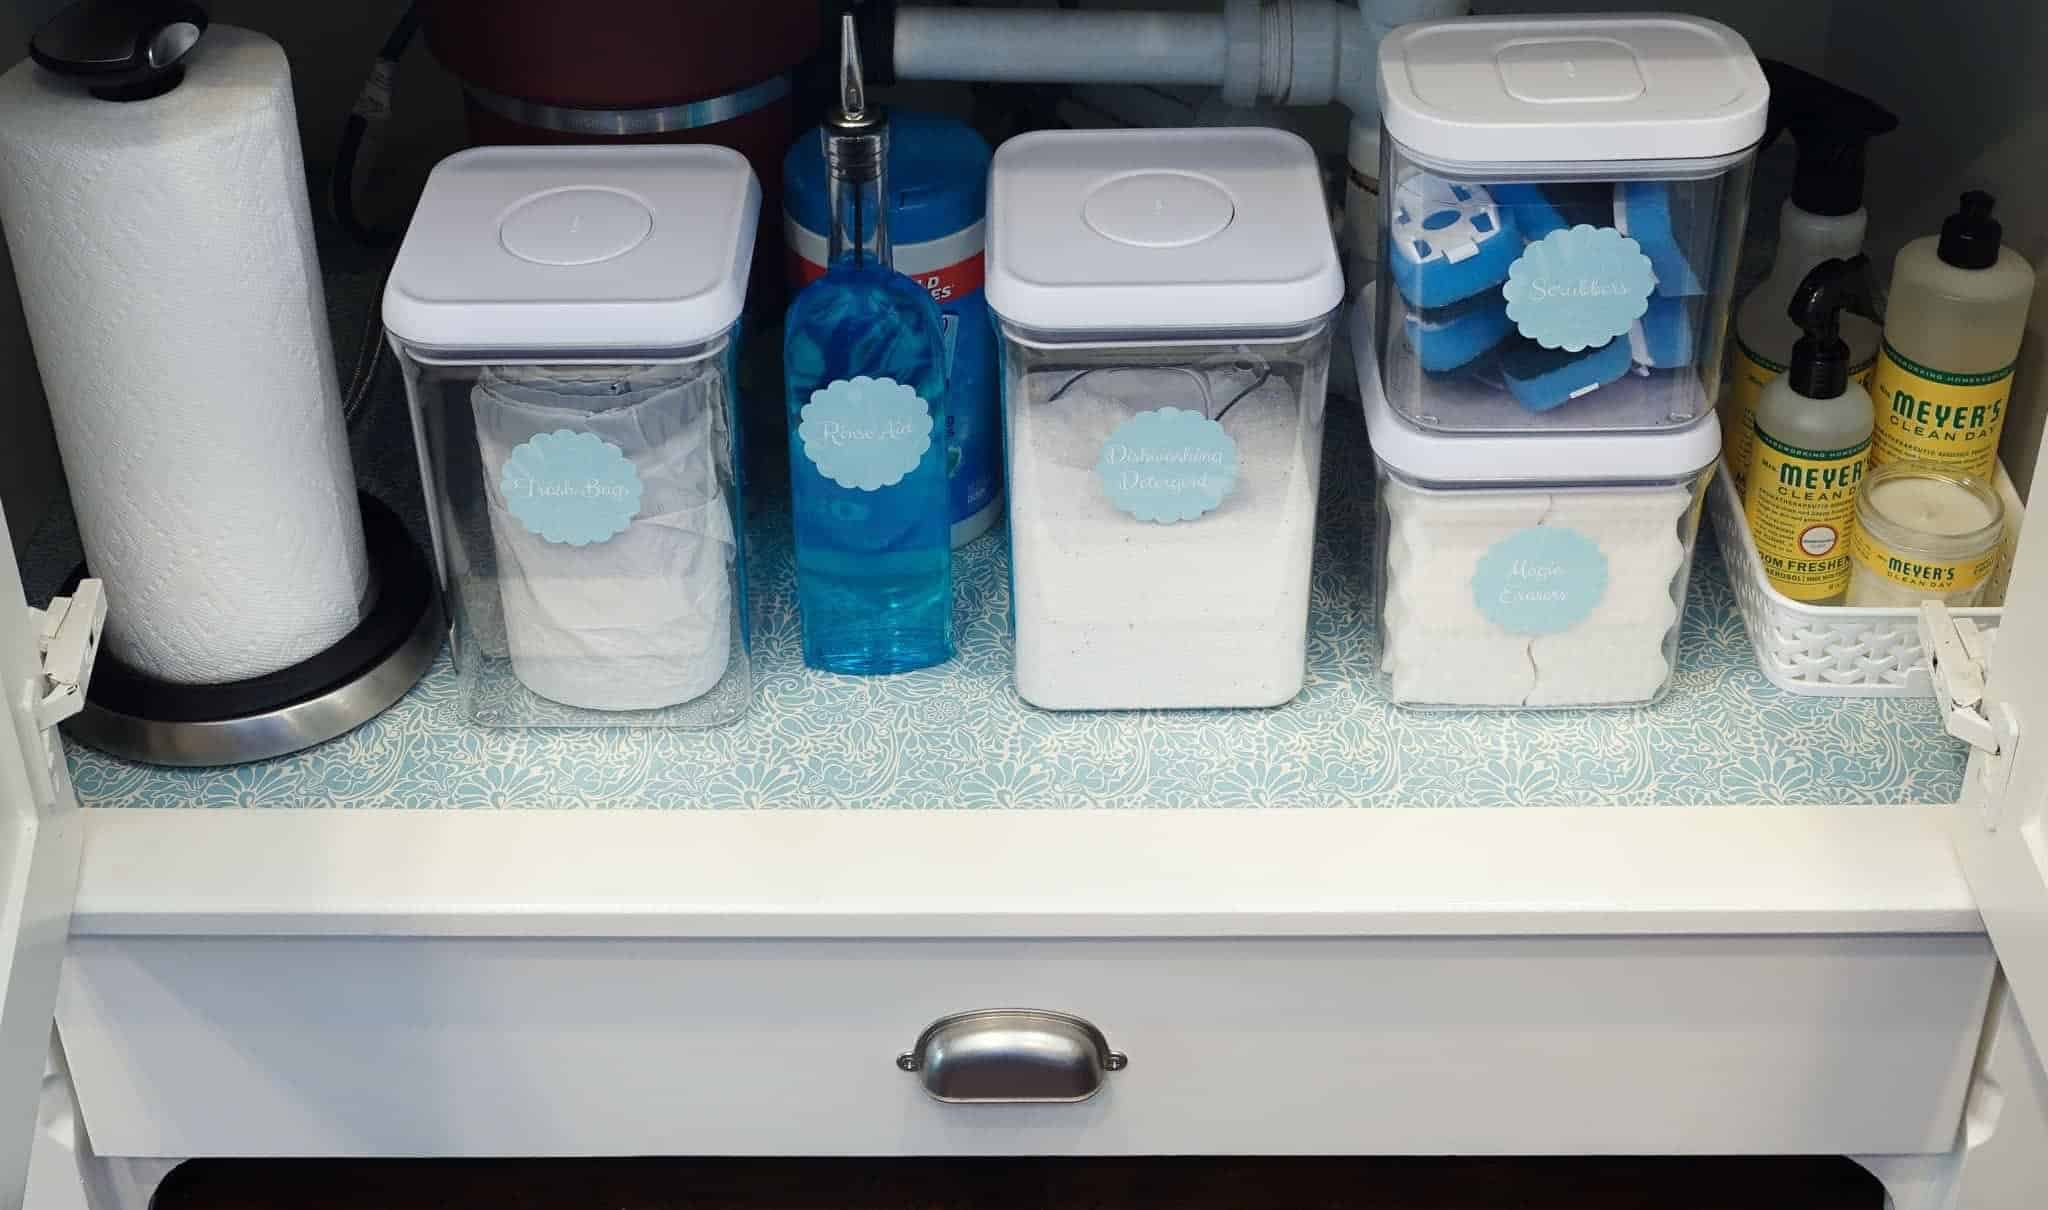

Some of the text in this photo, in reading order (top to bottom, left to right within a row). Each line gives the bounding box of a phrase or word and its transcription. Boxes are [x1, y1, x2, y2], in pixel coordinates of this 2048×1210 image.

[1889, 415, 1956, 441] CLEAN
[1777, 486, 1843, 501] CLEAN
[1888, 557, 1956, 581] MEYER'S
[1888, 571, 1926, 587] CLEAN
